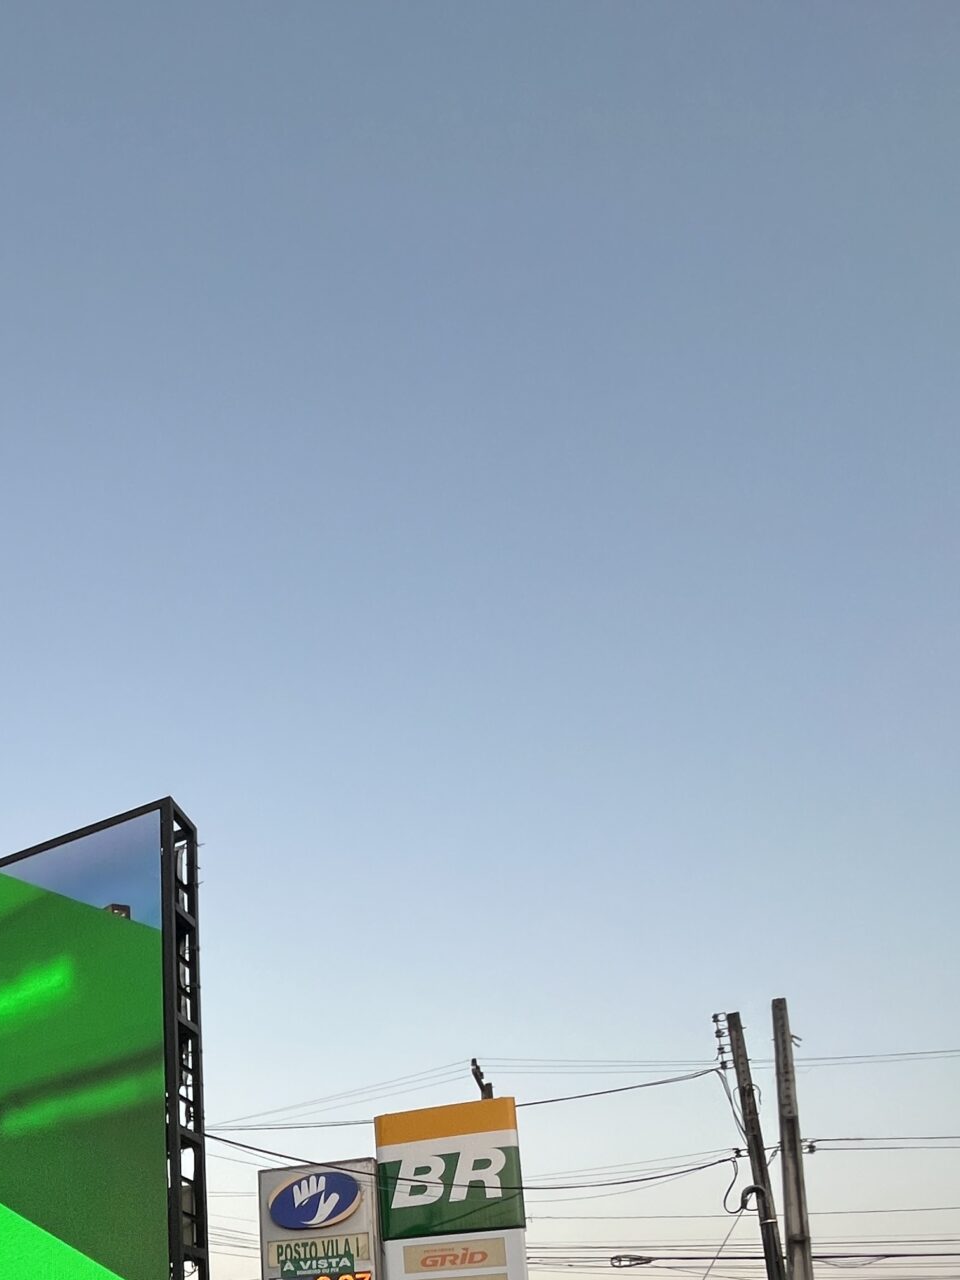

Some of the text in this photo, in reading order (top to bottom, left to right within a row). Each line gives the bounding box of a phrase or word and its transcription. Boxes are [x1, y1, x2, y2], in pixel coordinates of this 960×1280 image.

[391, 1147, 506, 1209] BR
[276, 1241, 318, 1264] POSTO
[322, 1238, 352, 1256] VILA
[299, 1257, 351, 1269] VISTA
